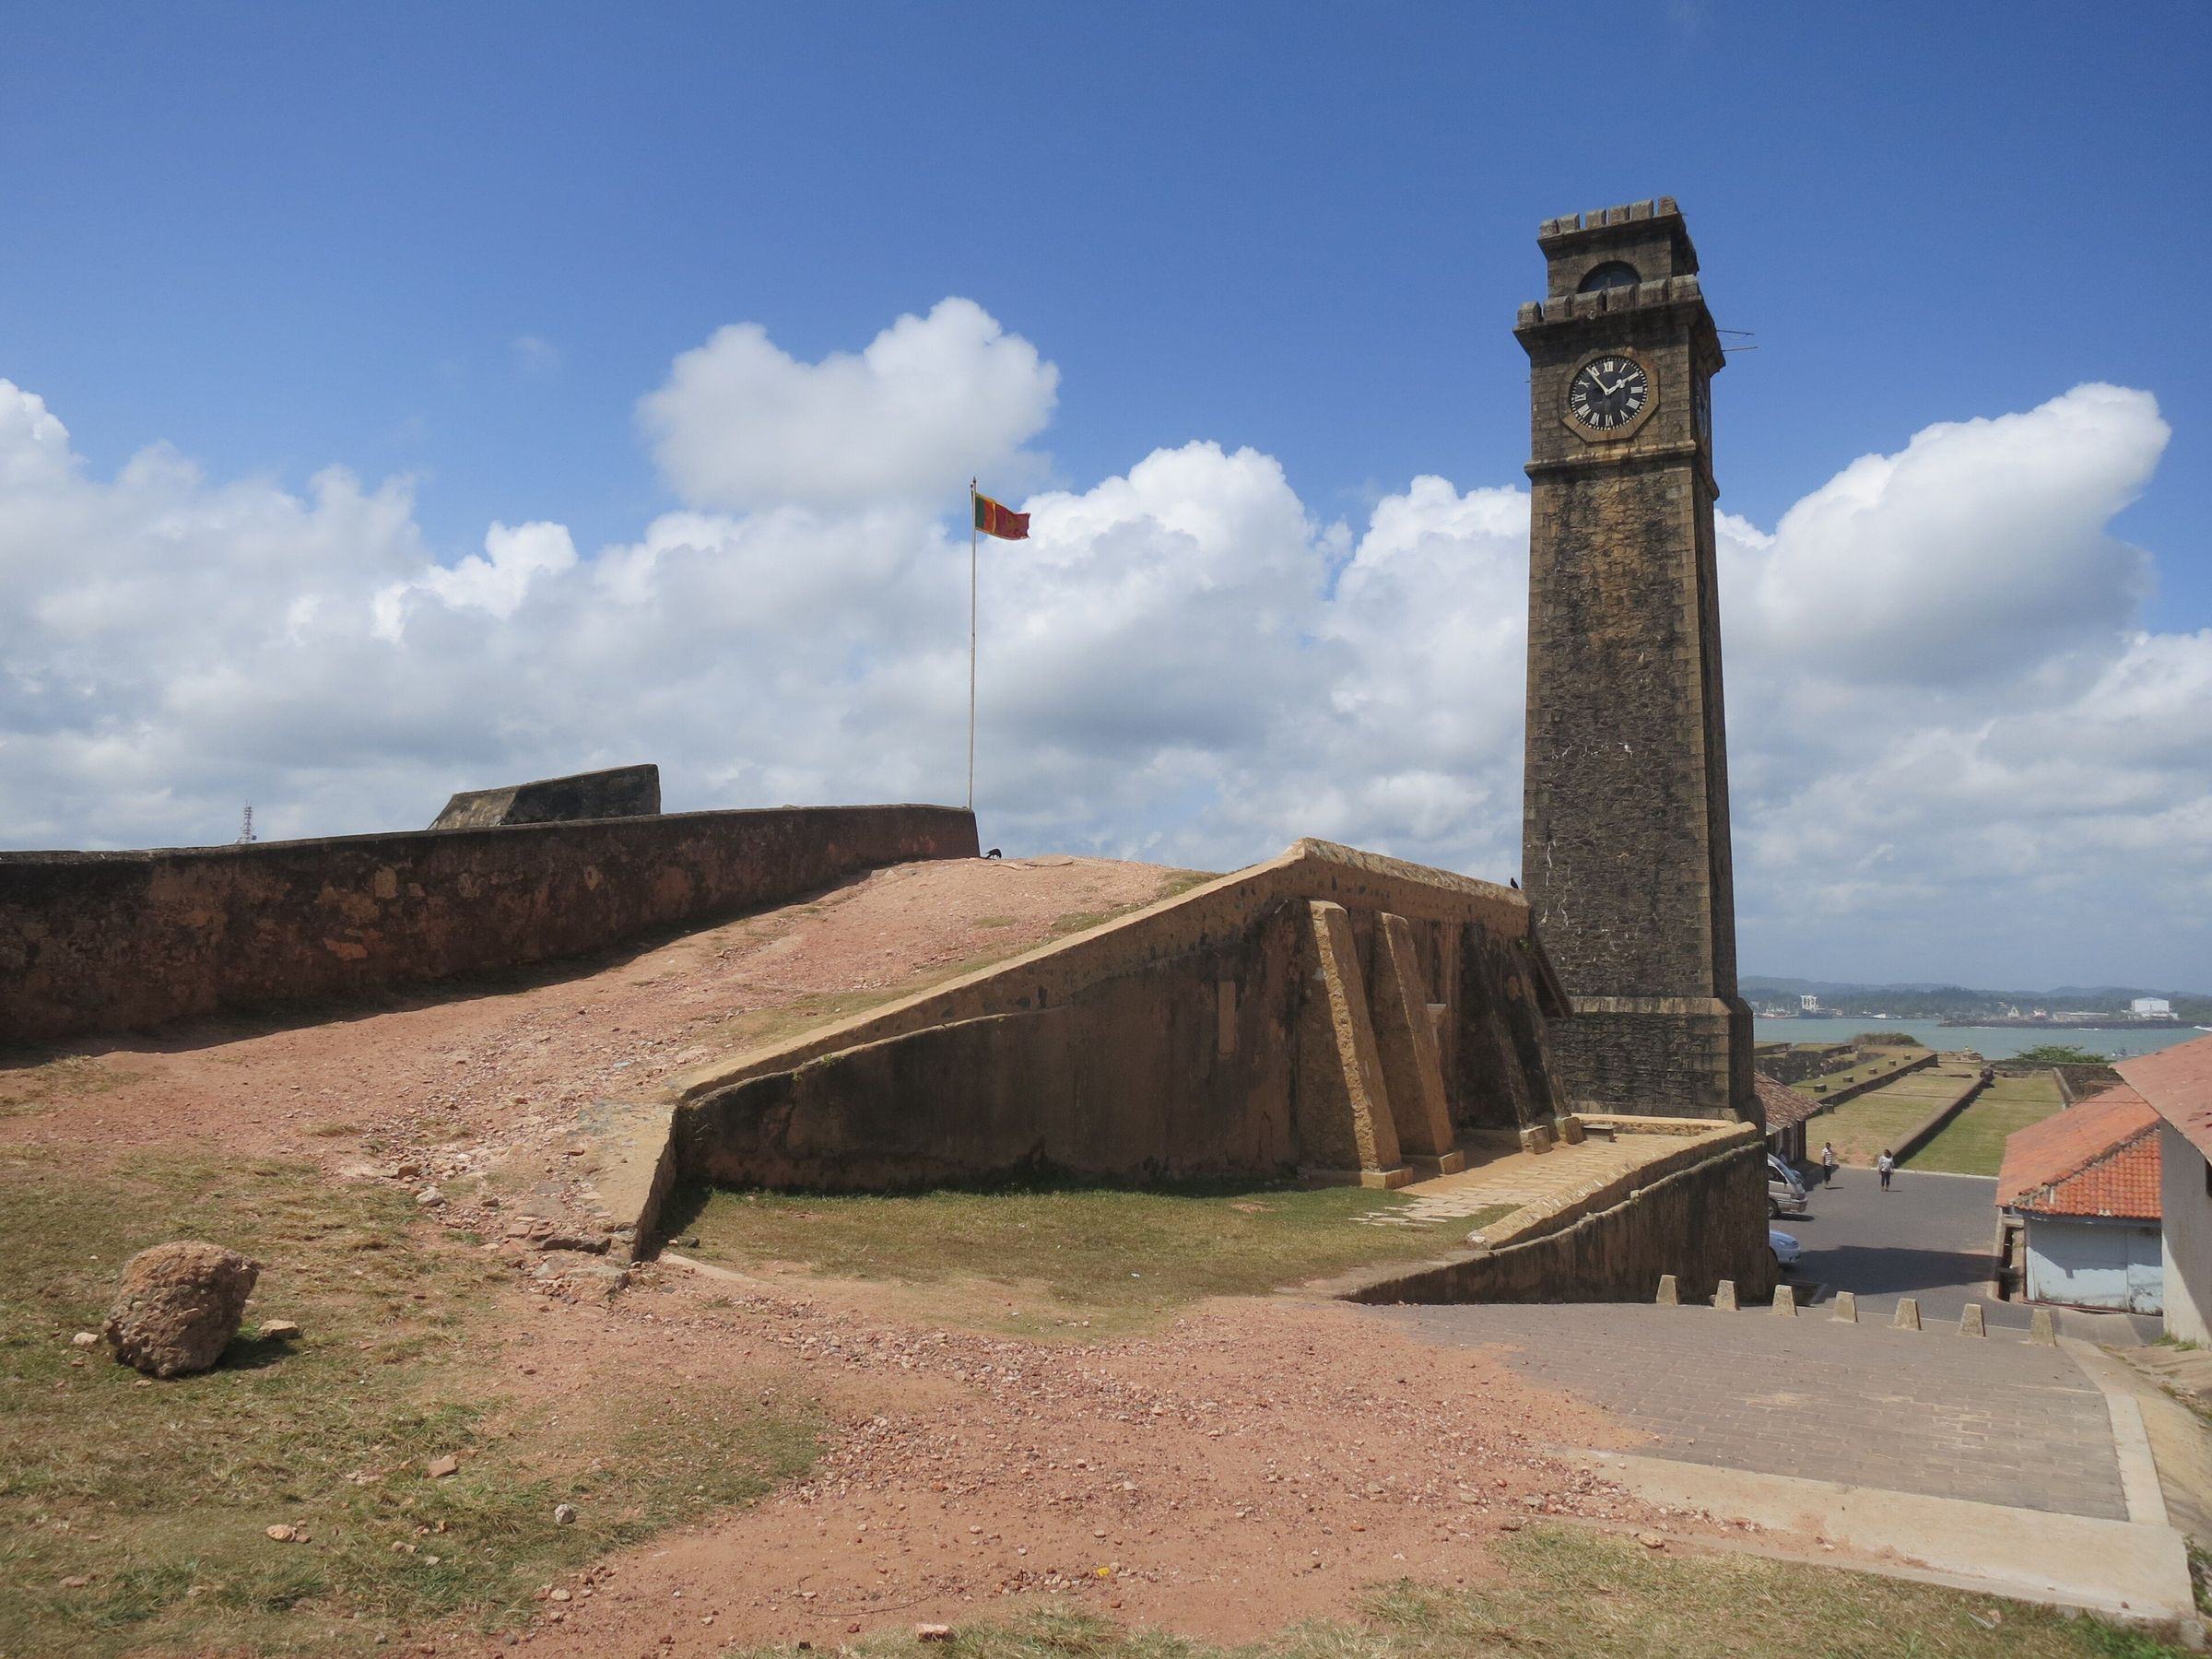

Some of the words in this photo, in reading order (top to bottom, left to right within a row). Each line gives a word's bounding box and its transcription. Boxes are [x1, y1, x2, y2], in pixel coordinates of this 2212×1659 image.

[1604, 361, 1614, 372] XII
[1578, 380, 1590, 388] X
[1574, 393, 1587, 402] IX
[1605, 414, 1613, 426] VI
[1619, 410, 1629, 420] V
